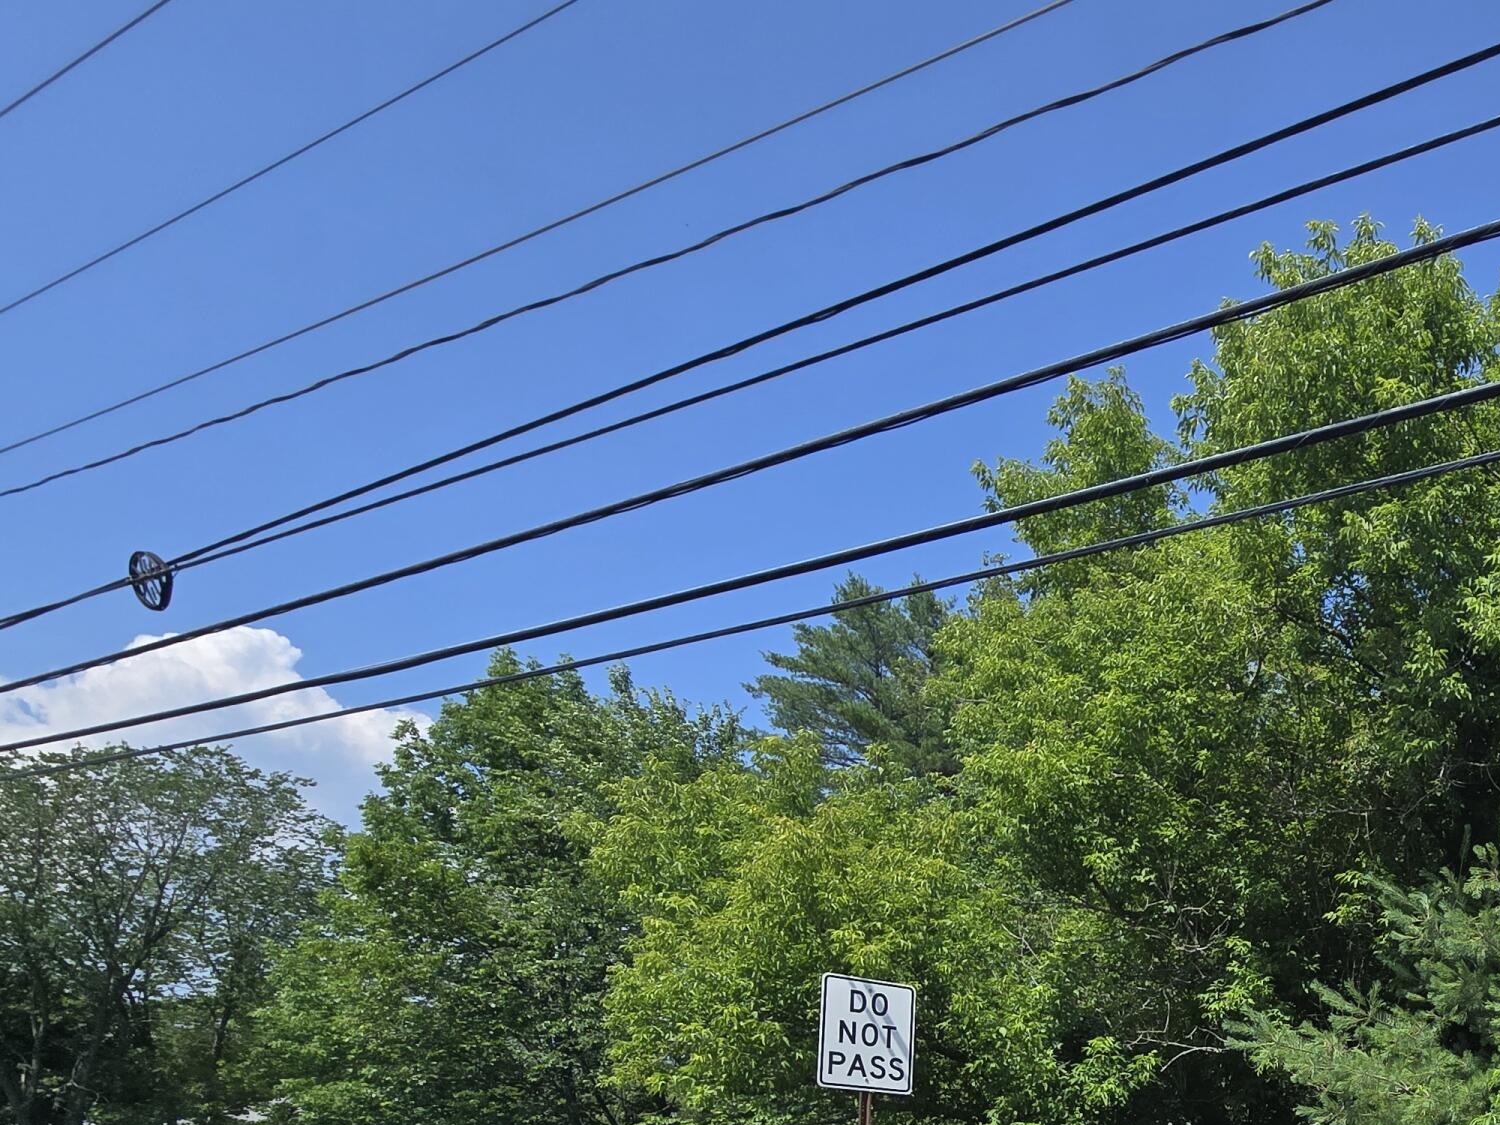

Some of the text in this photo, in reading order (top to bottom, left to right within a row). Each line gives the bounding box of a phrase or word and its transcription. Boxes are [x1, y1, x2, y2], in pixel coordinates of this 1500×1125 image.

[850, 989, 889, 1016] DO
[838, 1019, 897, 1049] NOT
[827, 1051, 905, 1081] PASS
